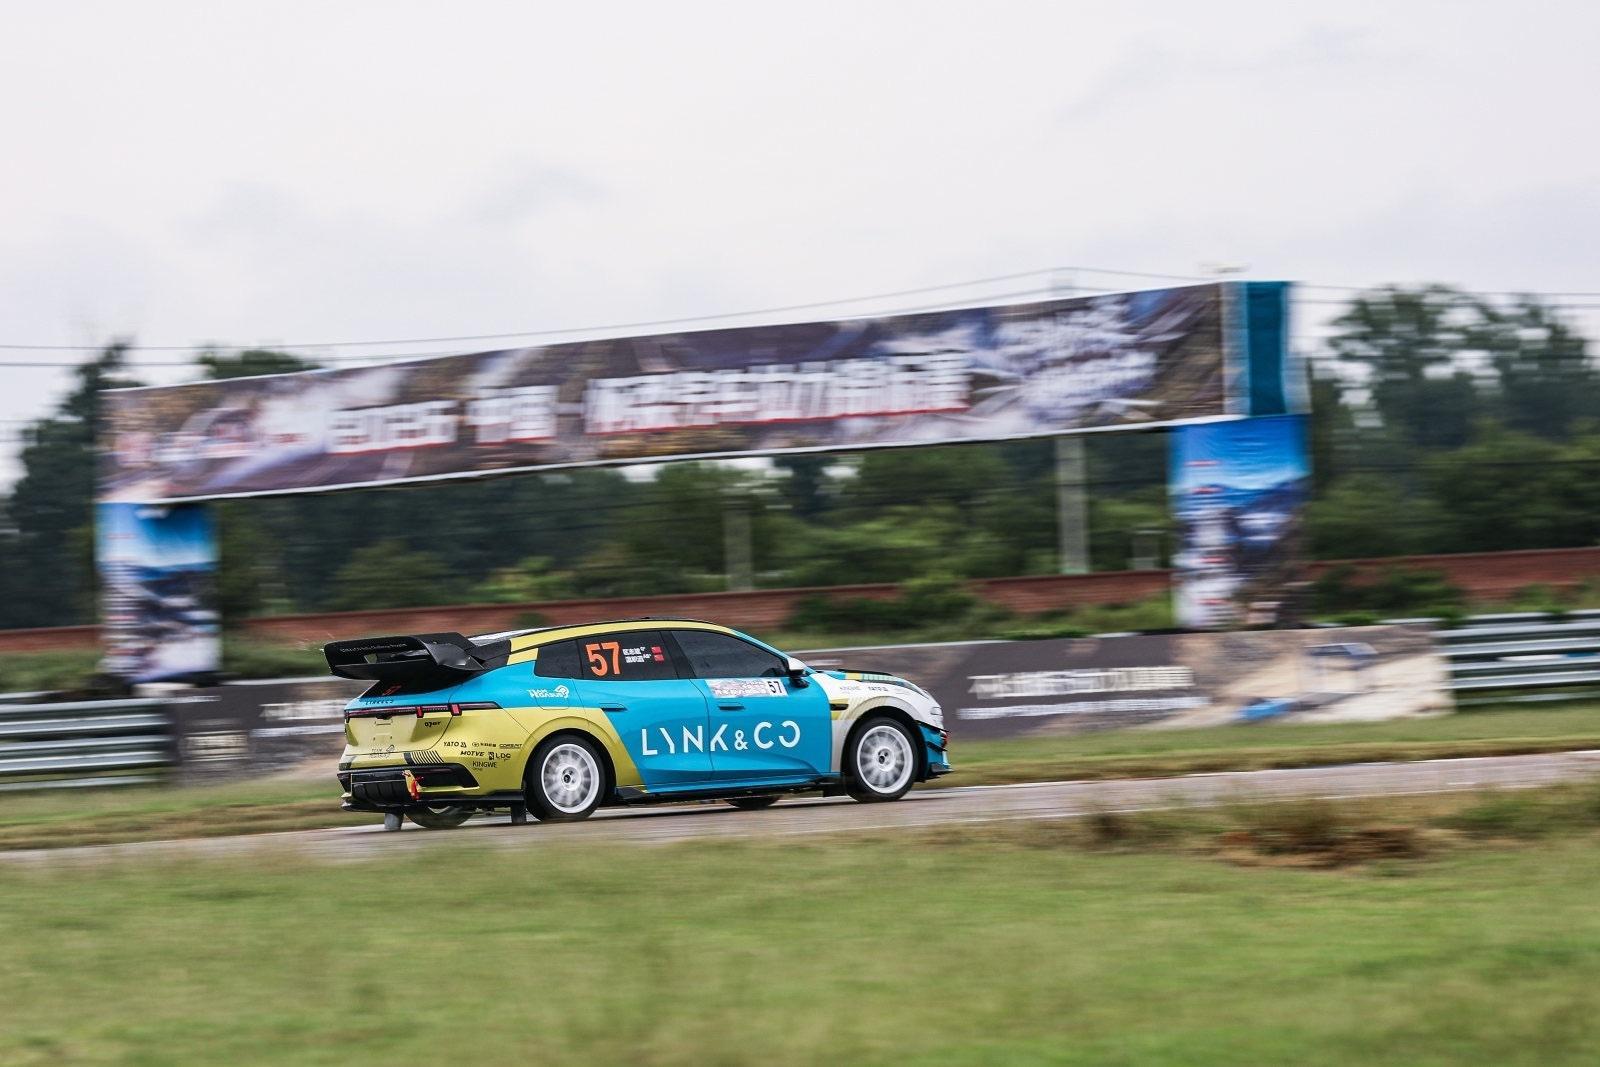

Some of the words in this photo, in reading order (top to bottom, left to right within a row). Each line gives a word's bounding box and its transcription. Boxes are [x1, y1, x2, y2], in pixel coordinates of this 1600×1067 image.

[585, 641, 621, 677] 57
[768, 681, 783, 694] 57
[472, 760, 498, 768] KINGWE
